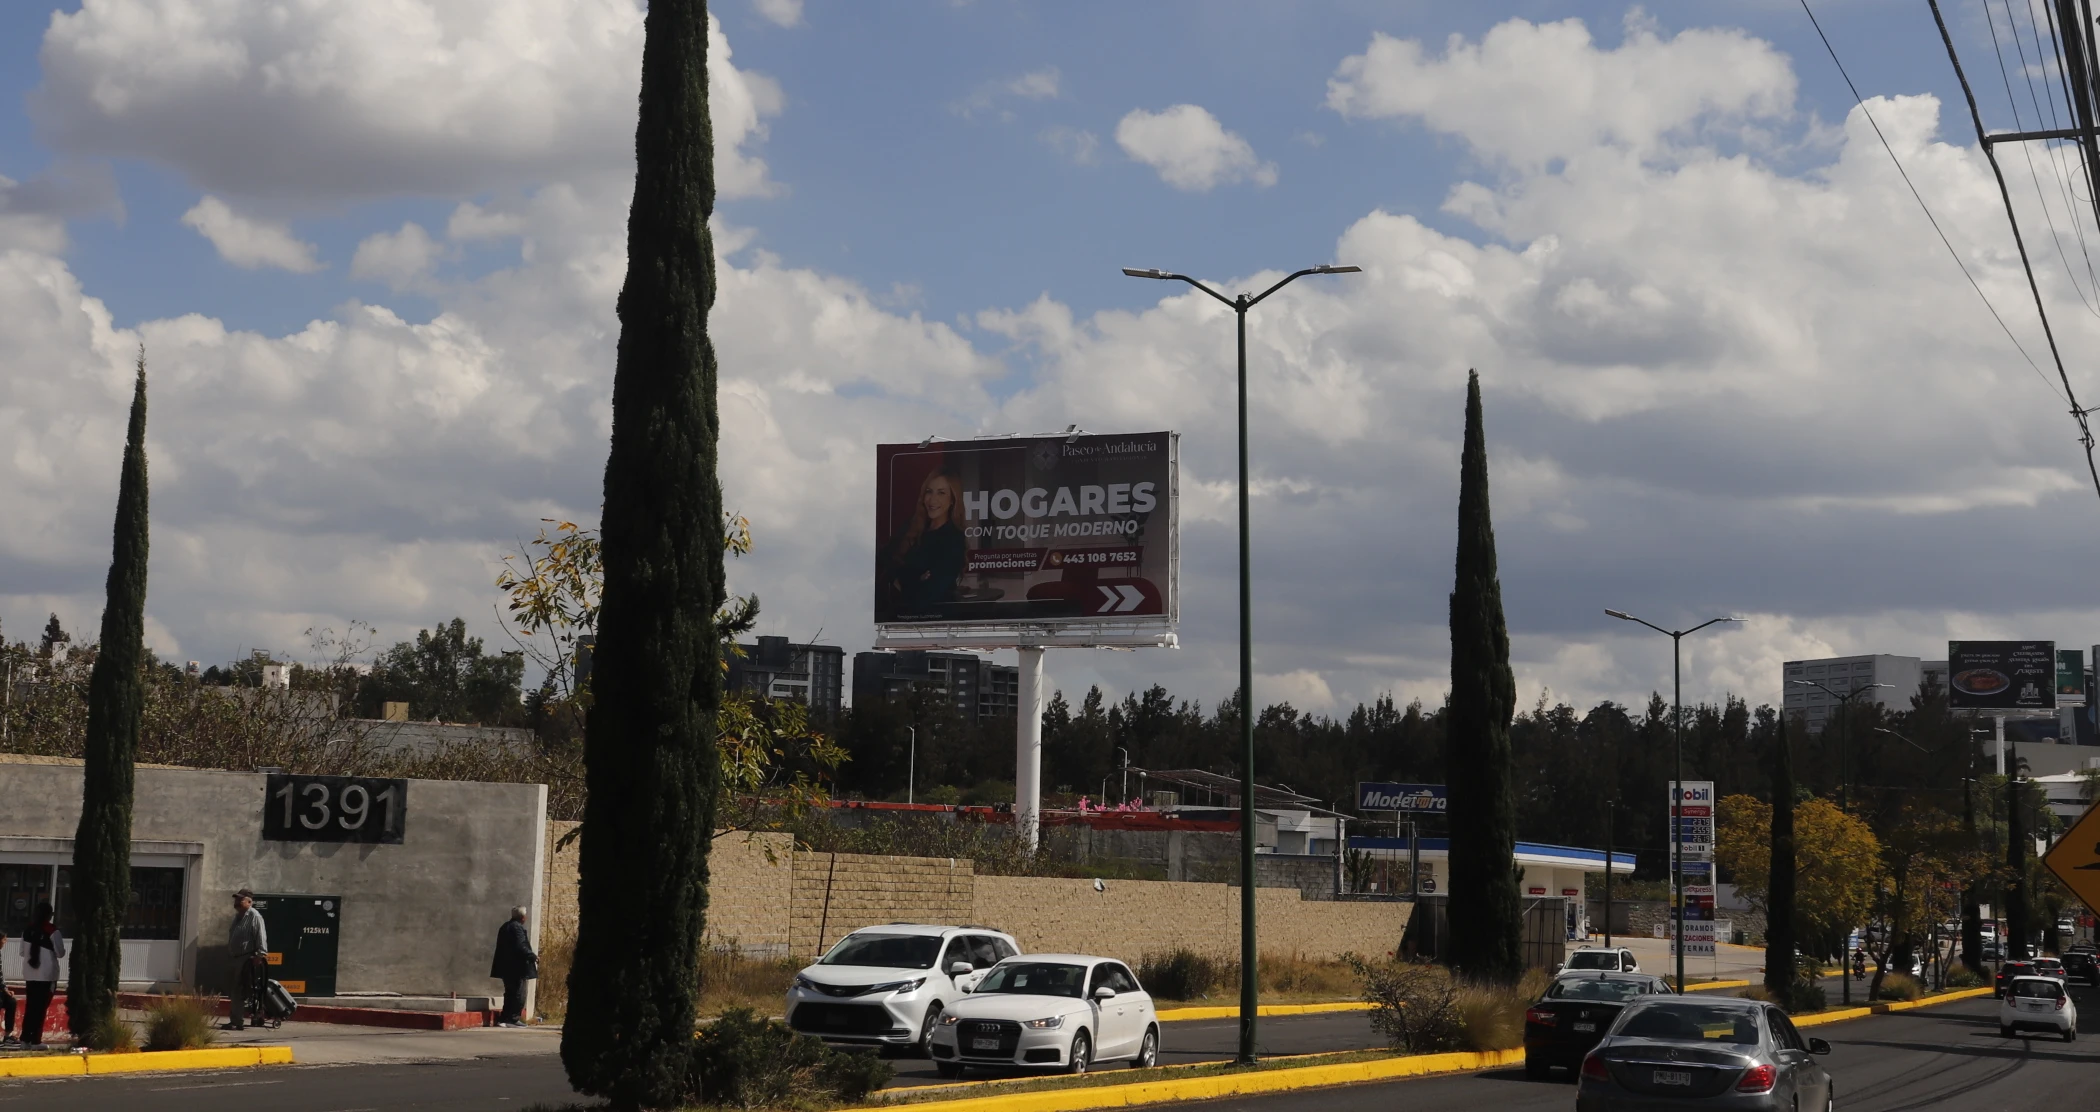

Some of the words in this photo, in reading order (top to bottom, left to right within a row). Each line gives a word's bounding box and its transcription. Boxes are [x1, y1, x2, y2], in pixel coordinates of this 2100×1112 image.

[1063, 444, 1094, 457] Paseo
[1103, 440, 1157, 454] Andalucía
[963, 482, 1157, 520] HOGARES
[964, 526, 993, 538] CON
[996, 523, 1050, 541] TOQUE
[1053, 519, 1138, 538] MODERNO
[968, 559, 1037, 571] promociones
[974, 553, 1002, 562] Pregunta
[1003, 553, 1013, 561] por
[1012, 551, 1037, 559] nuestras
[1063, 554, 1084, 564] 443
[1087, 553, 1107, 563] 108
[1109, 551, 1137, 562] 7652
[276, 782, 396, 832] 1391
